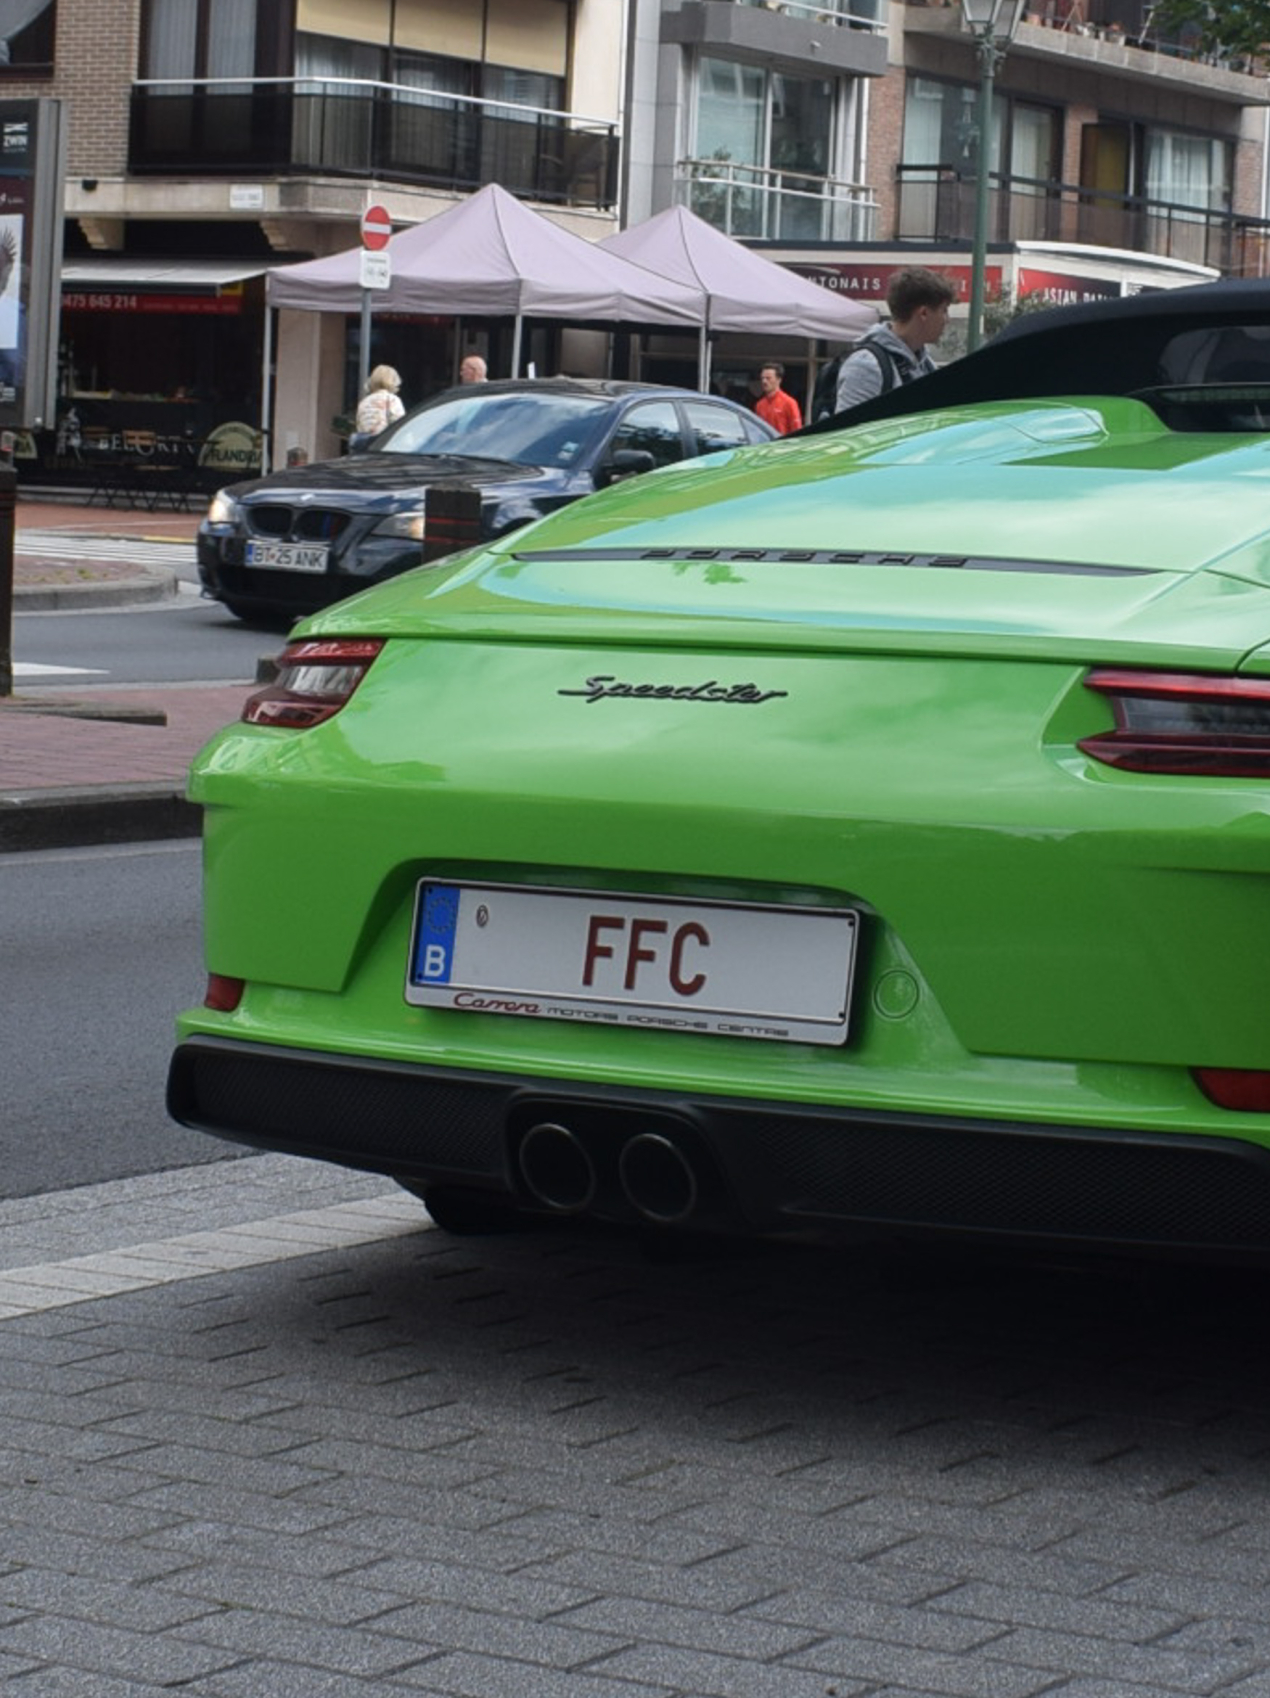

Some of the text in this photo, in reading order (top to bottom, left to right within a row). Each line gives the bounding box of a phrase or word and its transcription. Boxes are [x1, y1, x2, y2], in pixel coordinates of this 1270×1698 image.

[114, 295, 137, 309] 214
[640, 548, 969, 567] PORSCHE
[557, 675, 789, 704] Speedster
[424, 944, 446, 977] B
[582, 914, 711, 996] FFC
[453, 992, 541, 1014] Carrera
[627, 1014, 708, 1030] PORSCHE
